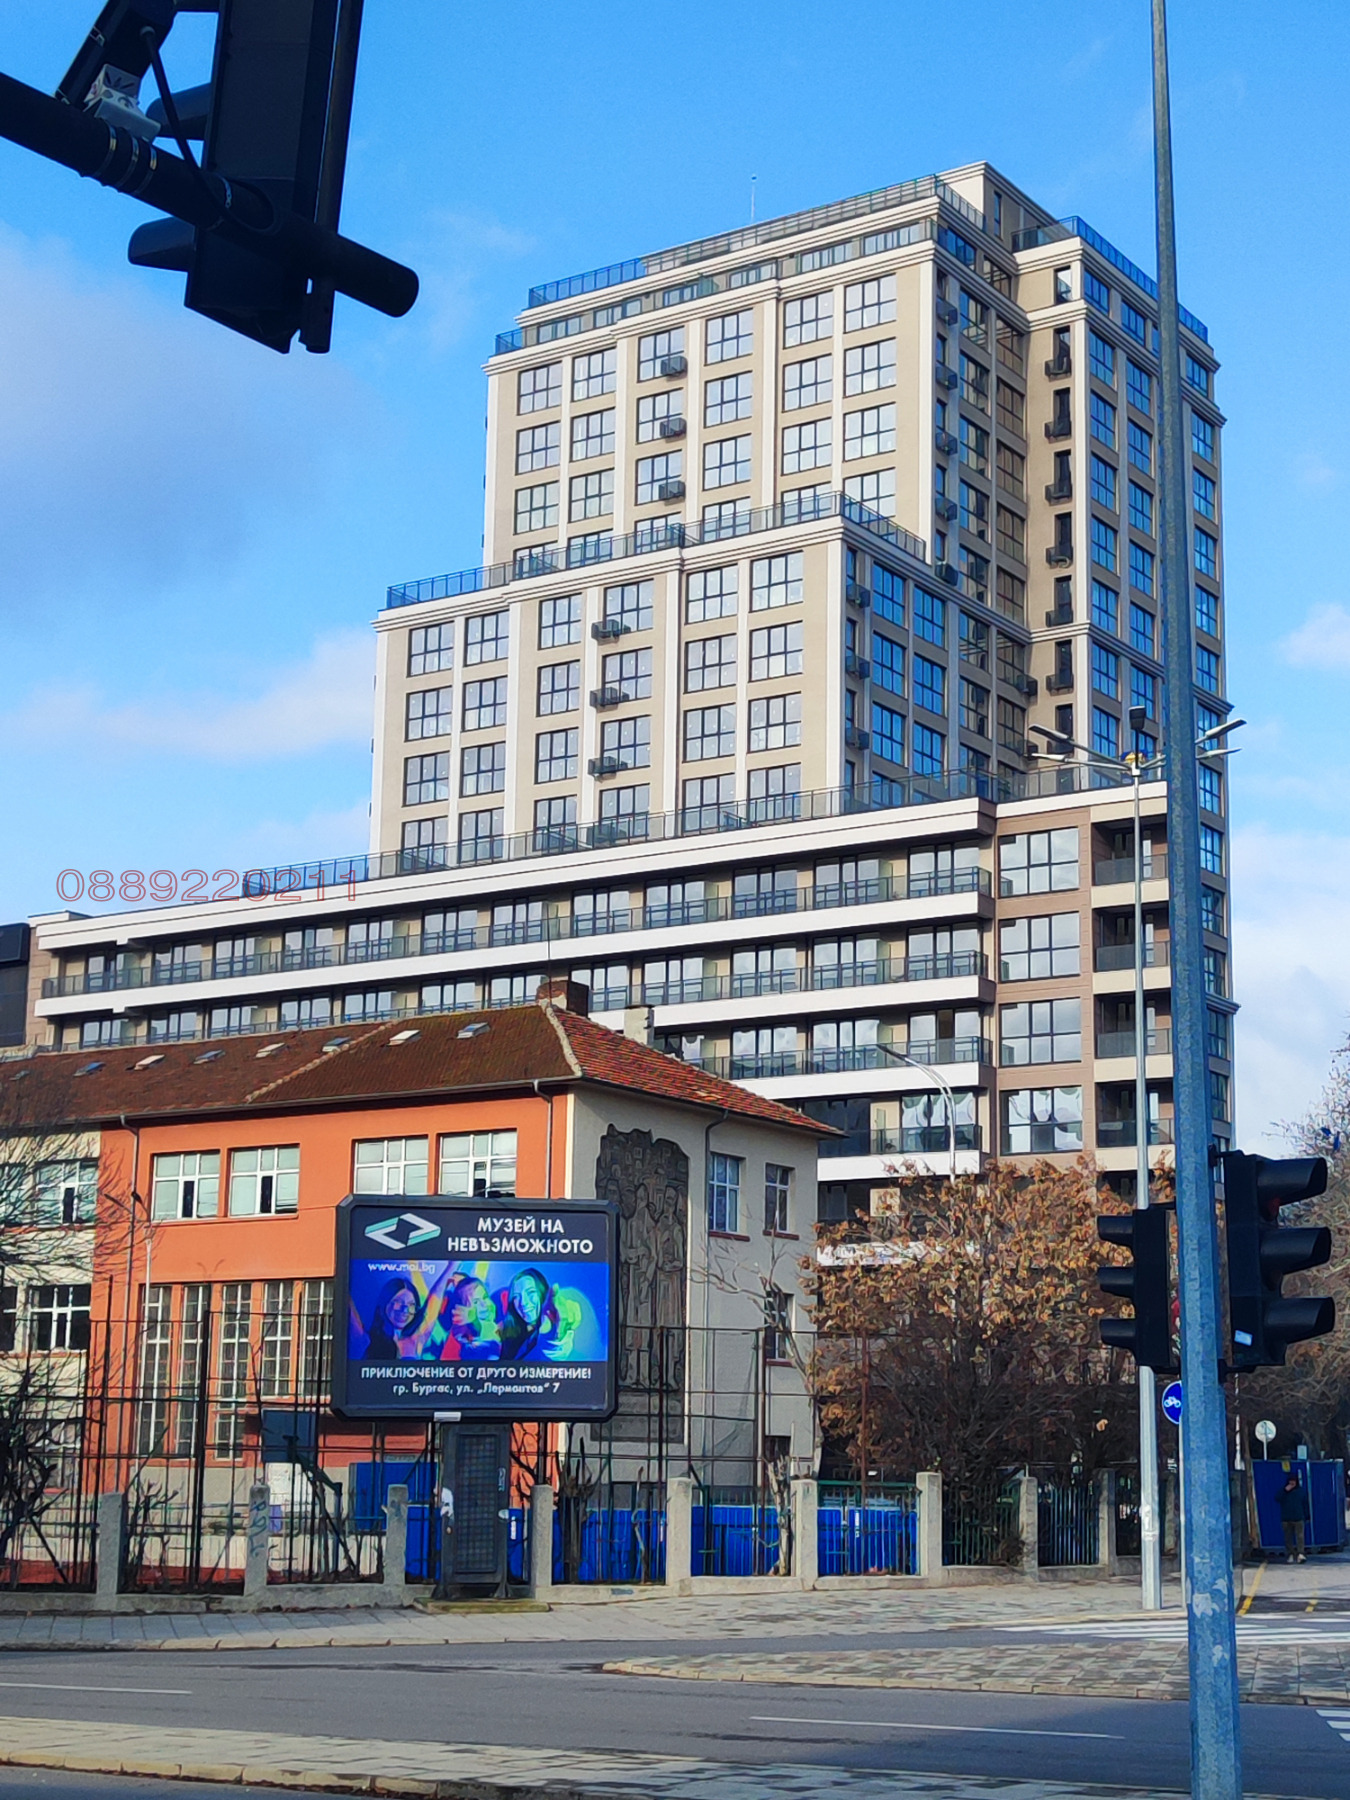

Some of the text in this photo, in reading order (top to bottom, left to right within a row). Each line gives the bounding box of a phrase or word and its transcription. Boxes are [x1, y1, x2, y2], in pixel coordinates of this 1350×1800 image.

[477, 1215, 564, 1233] МУЗЕЙ НА
[447, 1236, 593, 1254] НЕВЪЗМОЖНОТО
[361, 1366, 592, 1380] ПРИКЛЮЧЕНИЕ ОТ ДРУГО ИЗМЕРЕНИЕ!
[393, 1385, 409, 1396] гр.
[412, 1382, 453, 1396] Бургас,
[456, 1384, 474, 1396] ул.
[552, 1382, 560, 1393] 7
